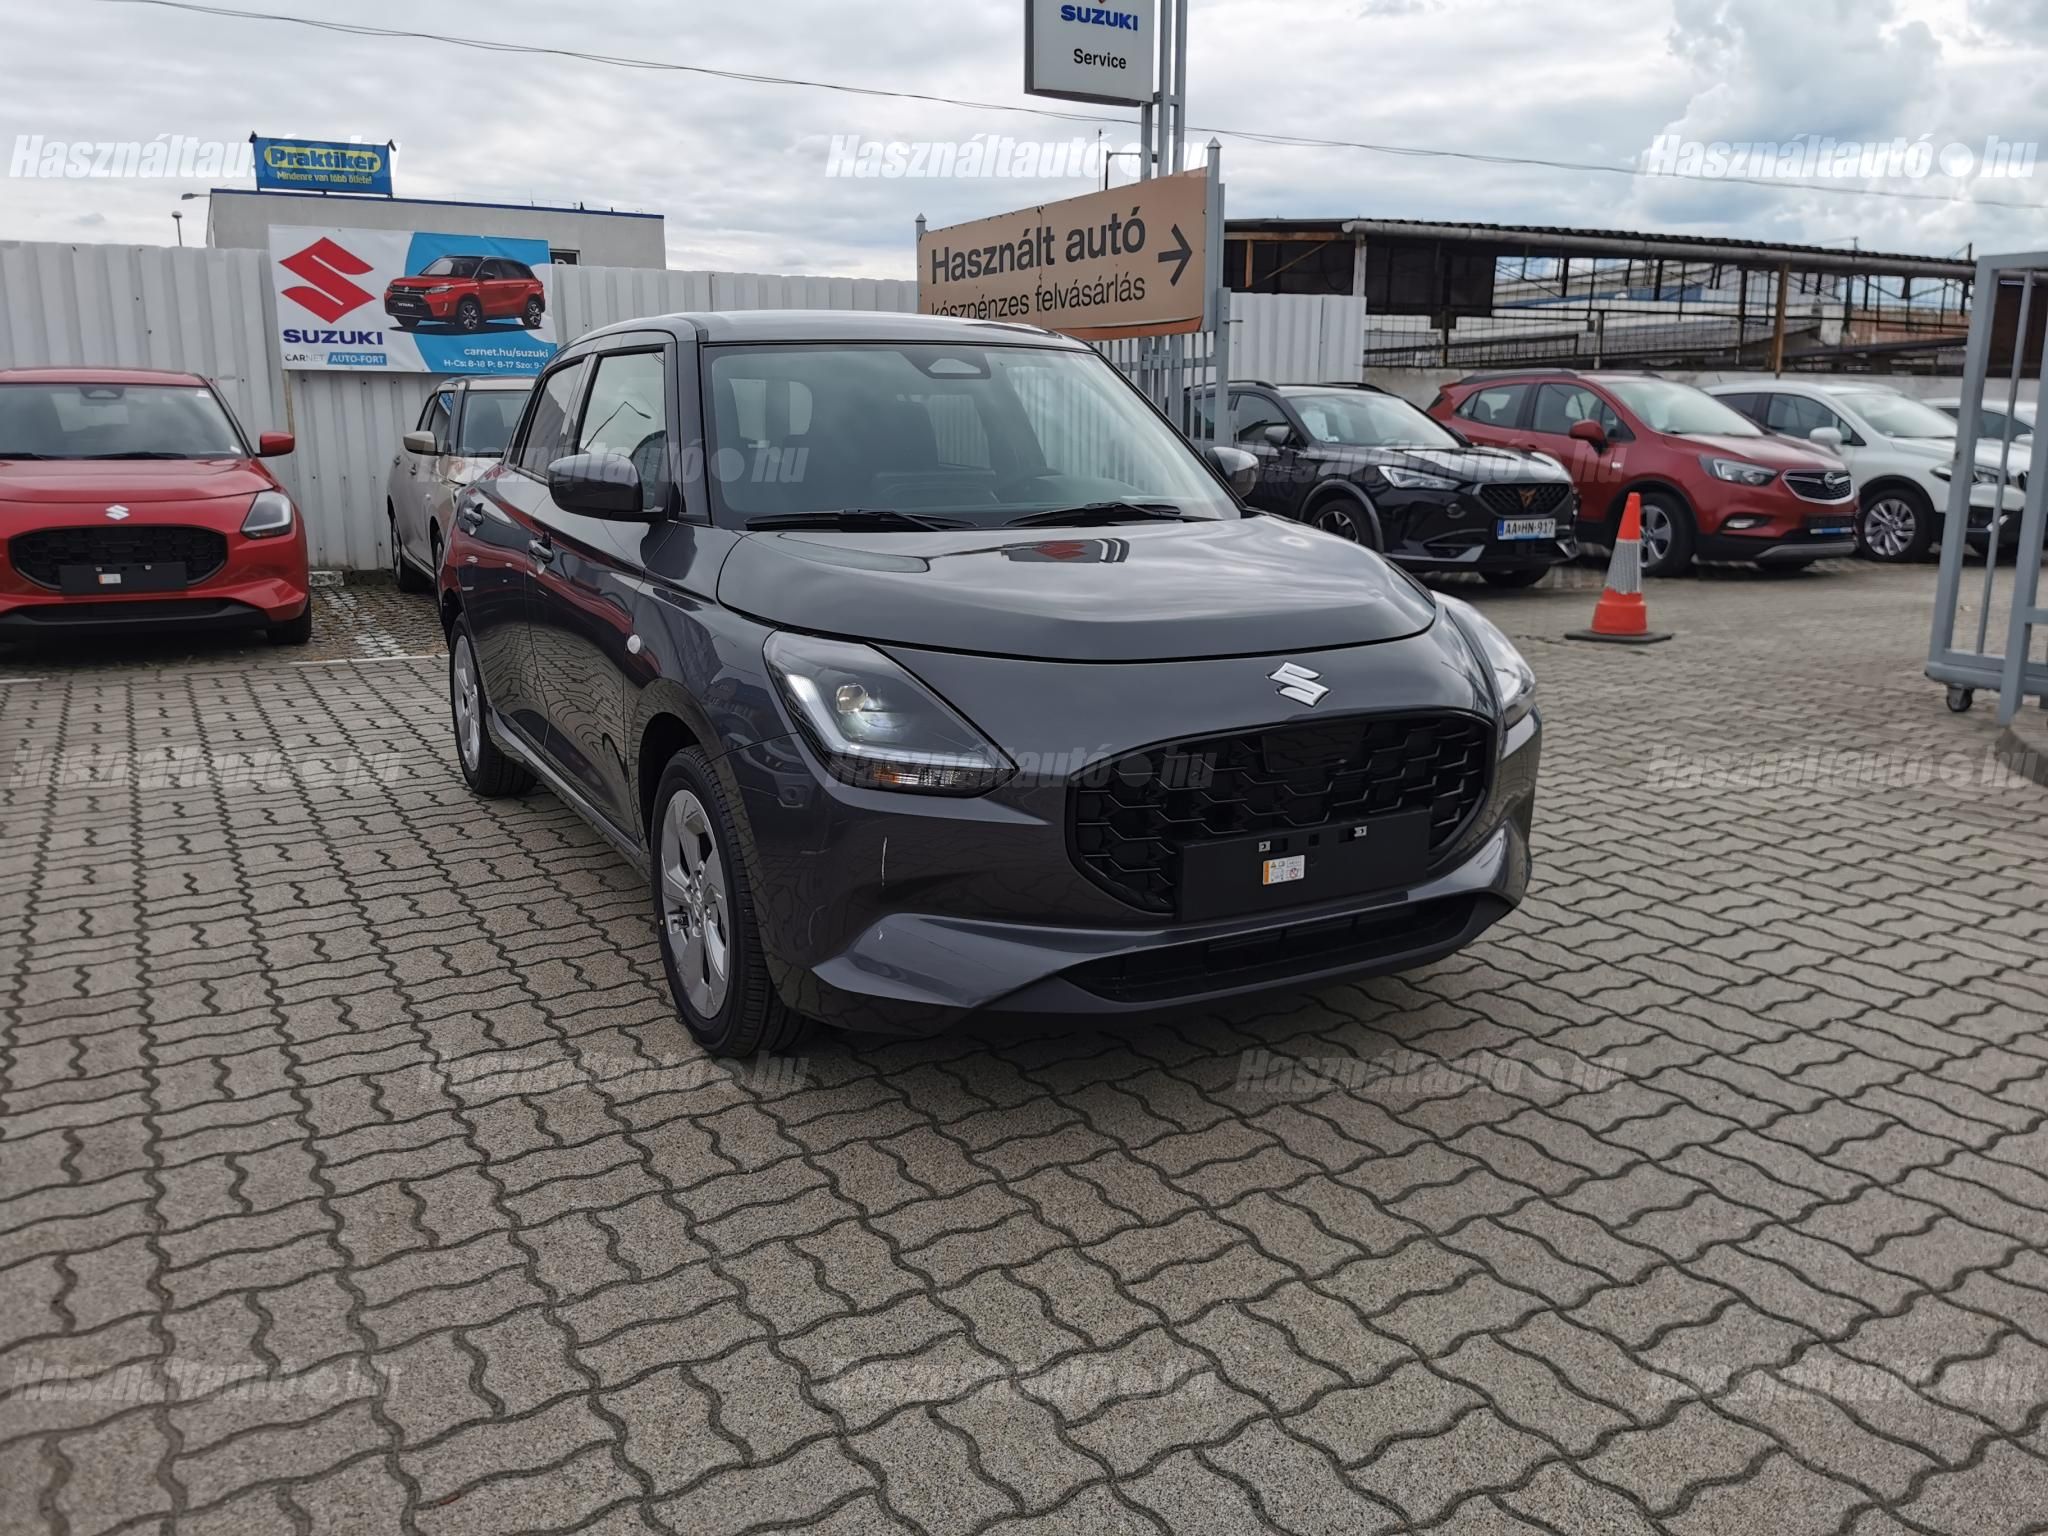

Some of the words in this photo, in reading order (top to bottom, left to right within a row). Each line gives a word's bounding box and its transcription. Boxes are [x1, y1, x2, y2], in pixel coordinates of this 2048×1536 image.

[1060, 4, 1138, 31] SUZUKI
[1073, 48, 1127, 70] Service
[270, 147, 378, 170] Praktiker
[931, 226, 1055, 285] Használt
[1065, 206, 1146, 263] autó
[1034, 271, 1146, 313] felvásárlás
[282, 328, 384, 345] SUZUKI
[331, 355, 385, 364] AUTO-FORT
[463, 347, 549, 358] carnet.hu/suzuki
